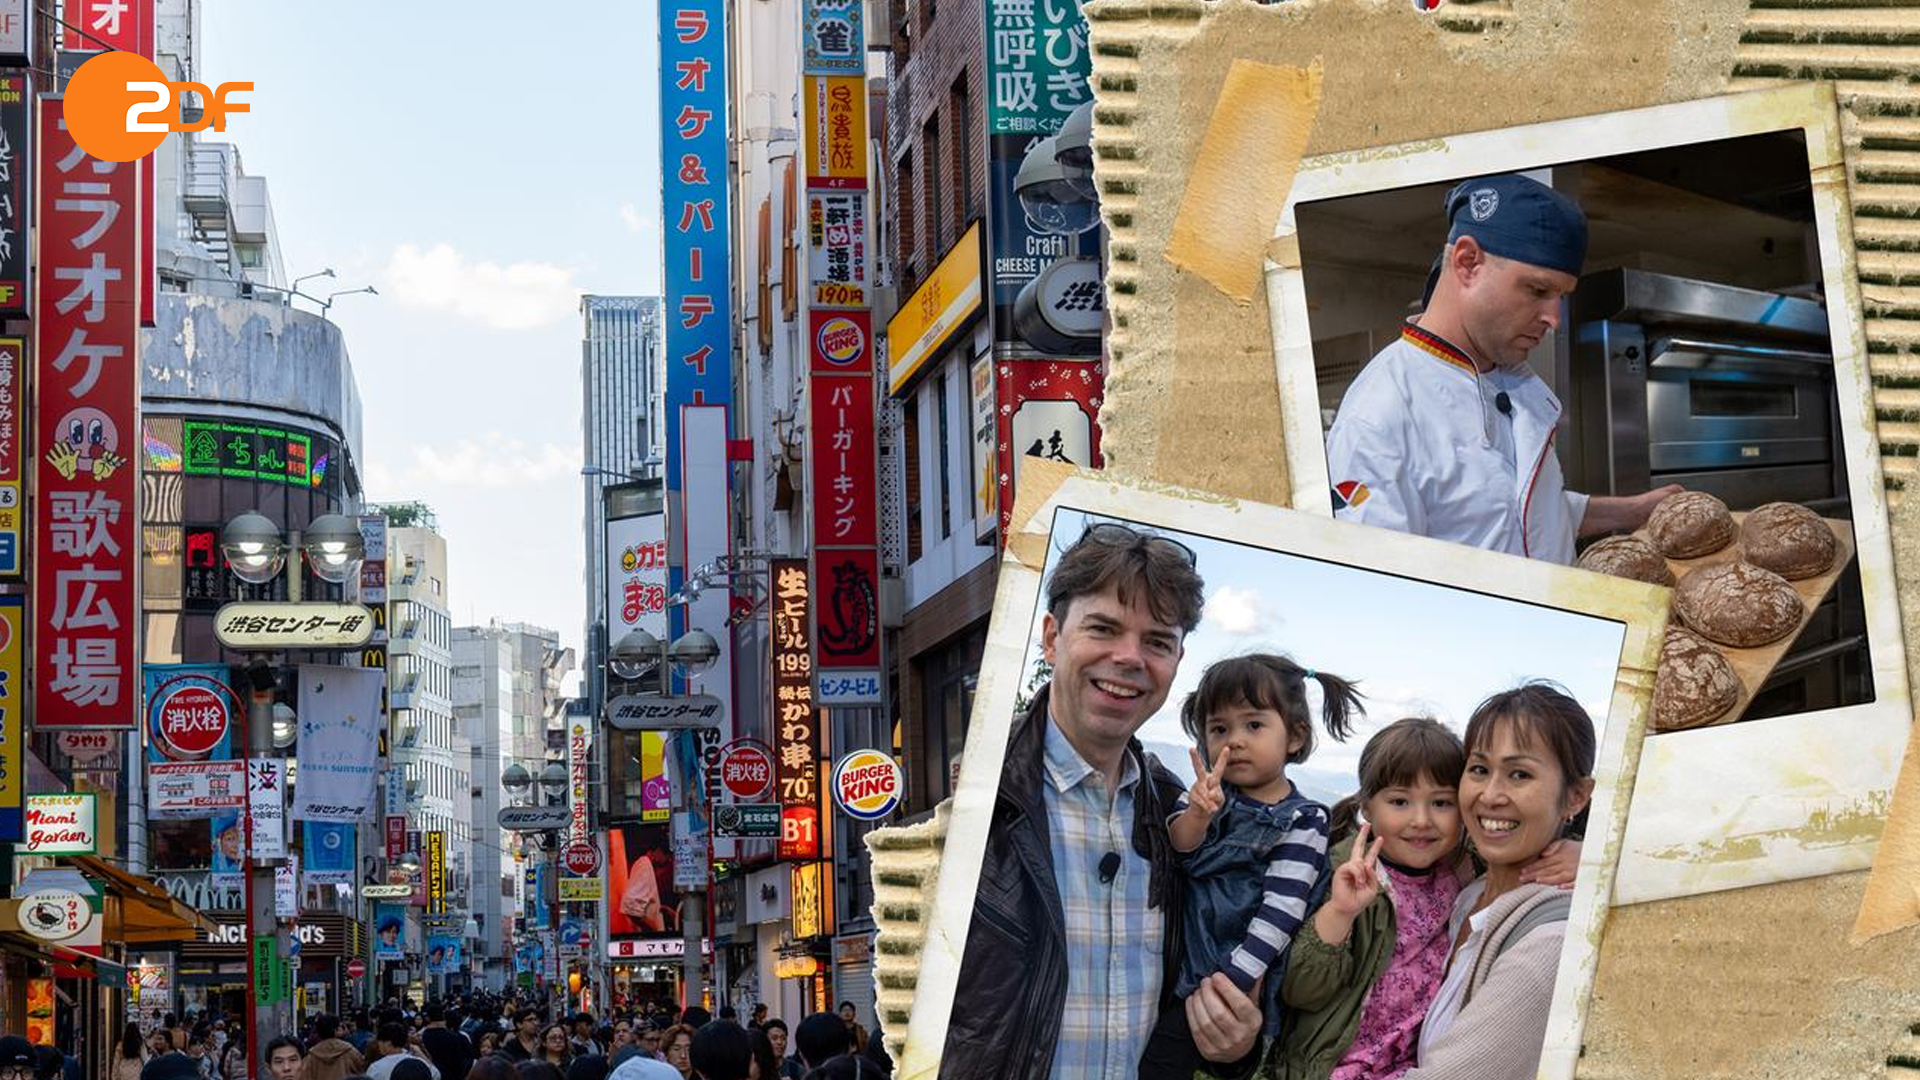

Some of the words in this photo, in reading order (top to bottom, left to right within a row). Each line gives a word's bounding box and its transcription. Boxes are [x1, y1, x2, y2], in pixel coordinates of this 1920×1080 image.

[815, 0, 850, 52] 雀
[994, 0, 1039, 112] 無呼吸
[1026, 235, 1063, 255] Craft
[996, 258, 1037, 272] CHEESE
[1040, 258, 1058, 272] M
[817, 286, 864, 304] 190円
[823, 326, 858, 346] BURGER
[825, 335, 859, 354] KING
[831, 386, 856, 538] バーガーキング
[50, 489, 122, 707] 歌広場
[778, 567, 808, 649] 生ビール
[223, 615, 366, 634] 渋谷センター街
[777, 653, 811, 671] 199
[820, 676, 879, 697] センタービル
[166, 705, 222, 733] 消火栓
[780, 703, 811, 770] かわ串
[572, 737, 586, 787] カラオケ
[726, 763, 767, 782] 消火栓
[842, 764, 893, 786] BURGER
[844, 776, 895, 803] KING
[27, 810, 78, 825] Miami
[783, 818, 813, 842] B1
